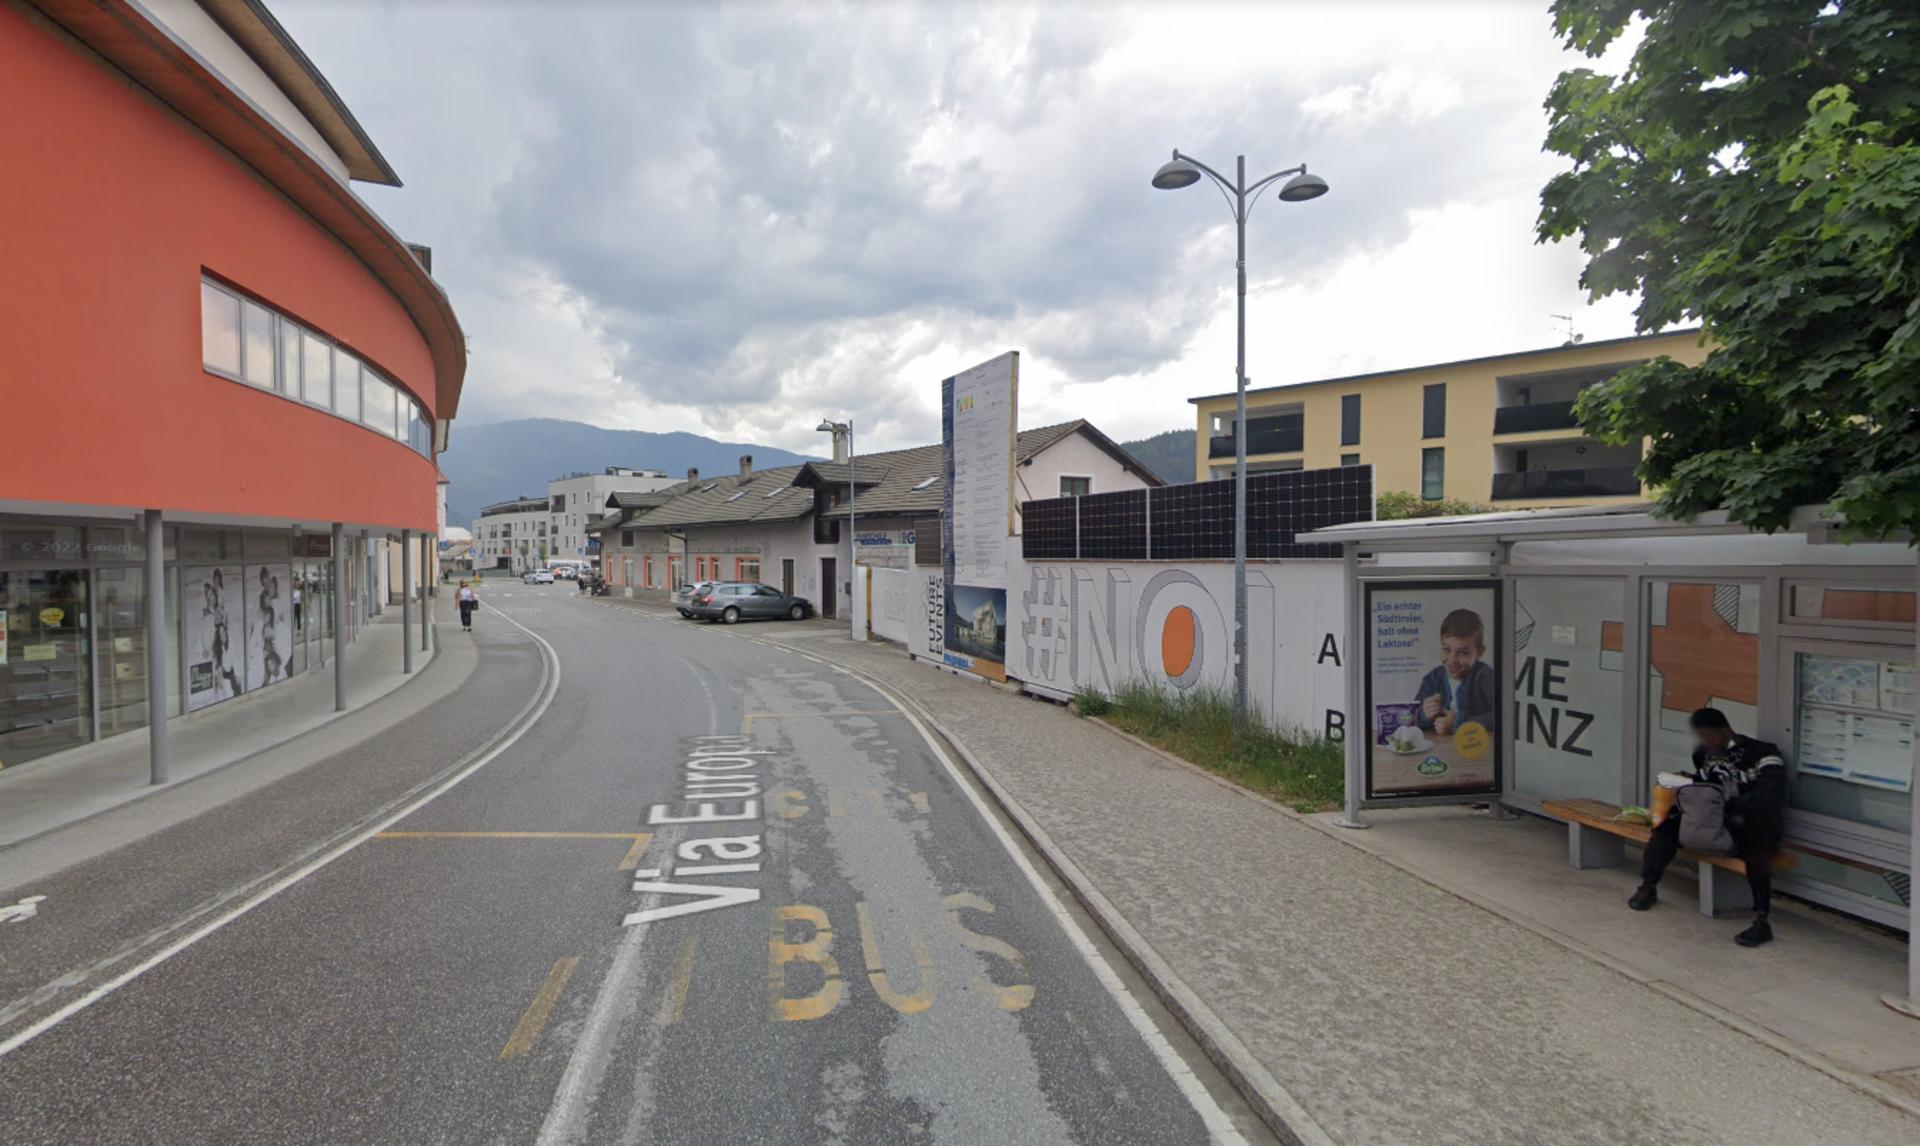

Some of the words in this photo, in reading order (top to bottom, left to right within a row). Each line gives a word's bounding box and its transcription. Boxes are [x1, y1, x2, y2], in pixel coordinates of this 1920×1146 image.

[928, 574, 937, 653] FUTURE
[935, 577, 943, 656] EVENTS
[1378, 626, 1395, 636] halt
[1396, 626, 1419, 636] ohne
[1394, 601, 1422, 611] echter
[768, 892, 1036, 1021] BUS
